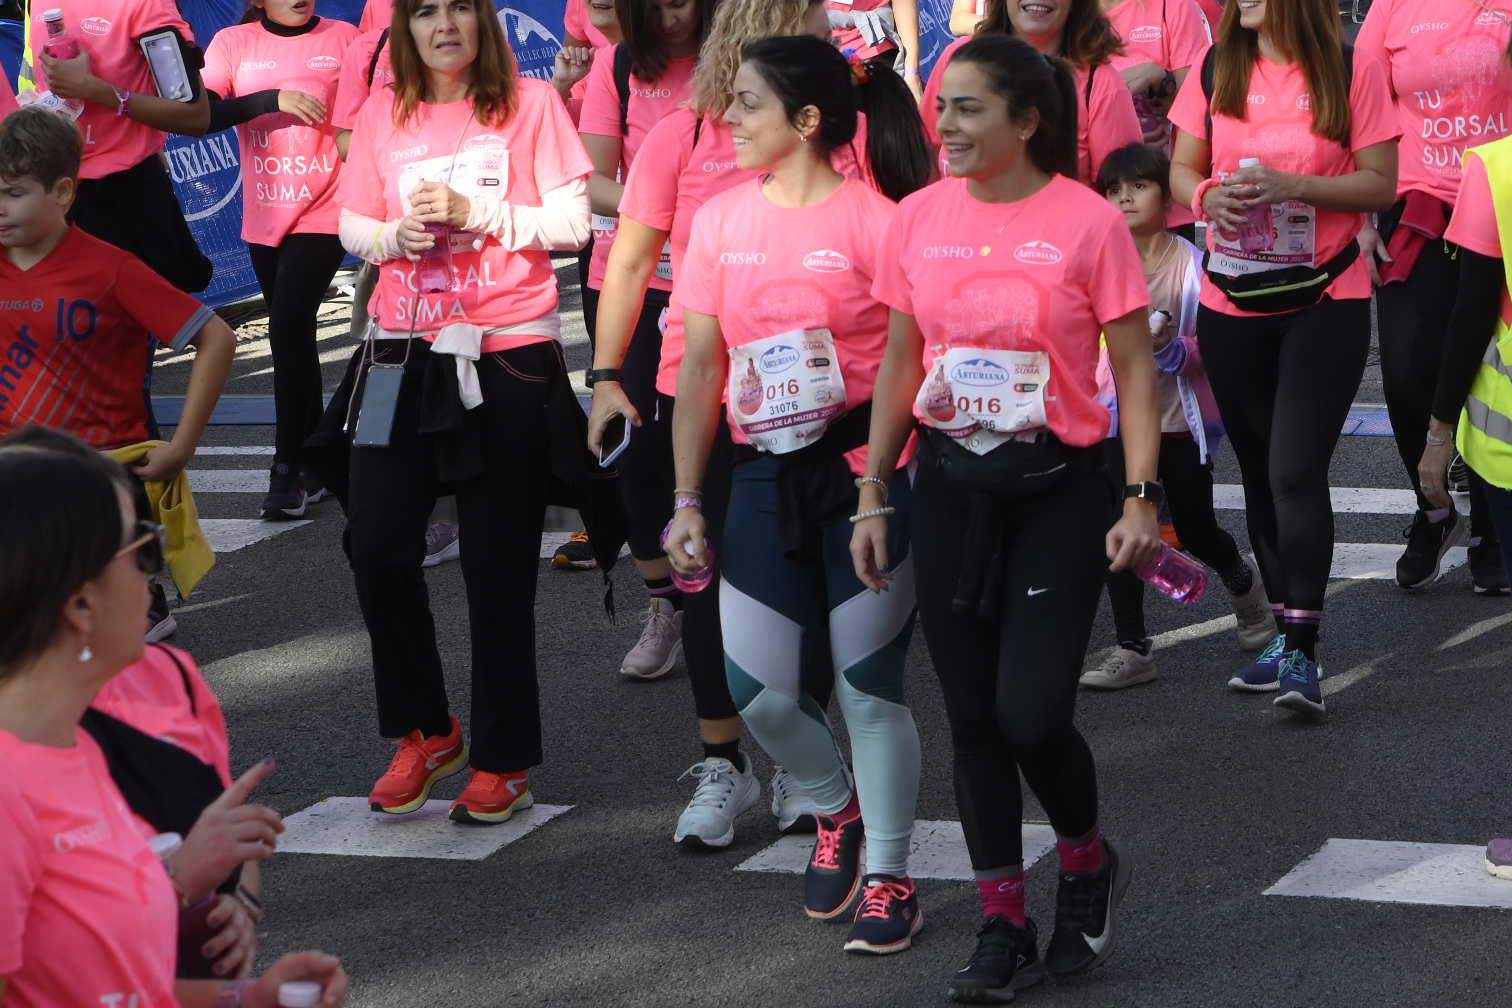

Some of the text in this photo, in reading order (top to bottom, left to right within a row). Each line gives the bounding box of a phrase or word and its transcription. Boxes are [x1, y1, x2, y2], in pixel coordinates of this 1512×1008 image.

[1409, 20, 1450, 34] OYSHO
[1413, 90, 1442, 110] TU
[1421, 113, 1509, 138] DORSAL
[254, 155, 333, 175] DORSAL
[256, 182, 313, 201] SUMA
[720, 252, 766, 265] OYSHO
[922, 246, 974, 259] OYSHO
[395, 295, 469, 321] SUMA
[766, 378, 800, 401] 016
[768, 400, 799, 416] 31076
[956, 396, 1002, 414] 016
